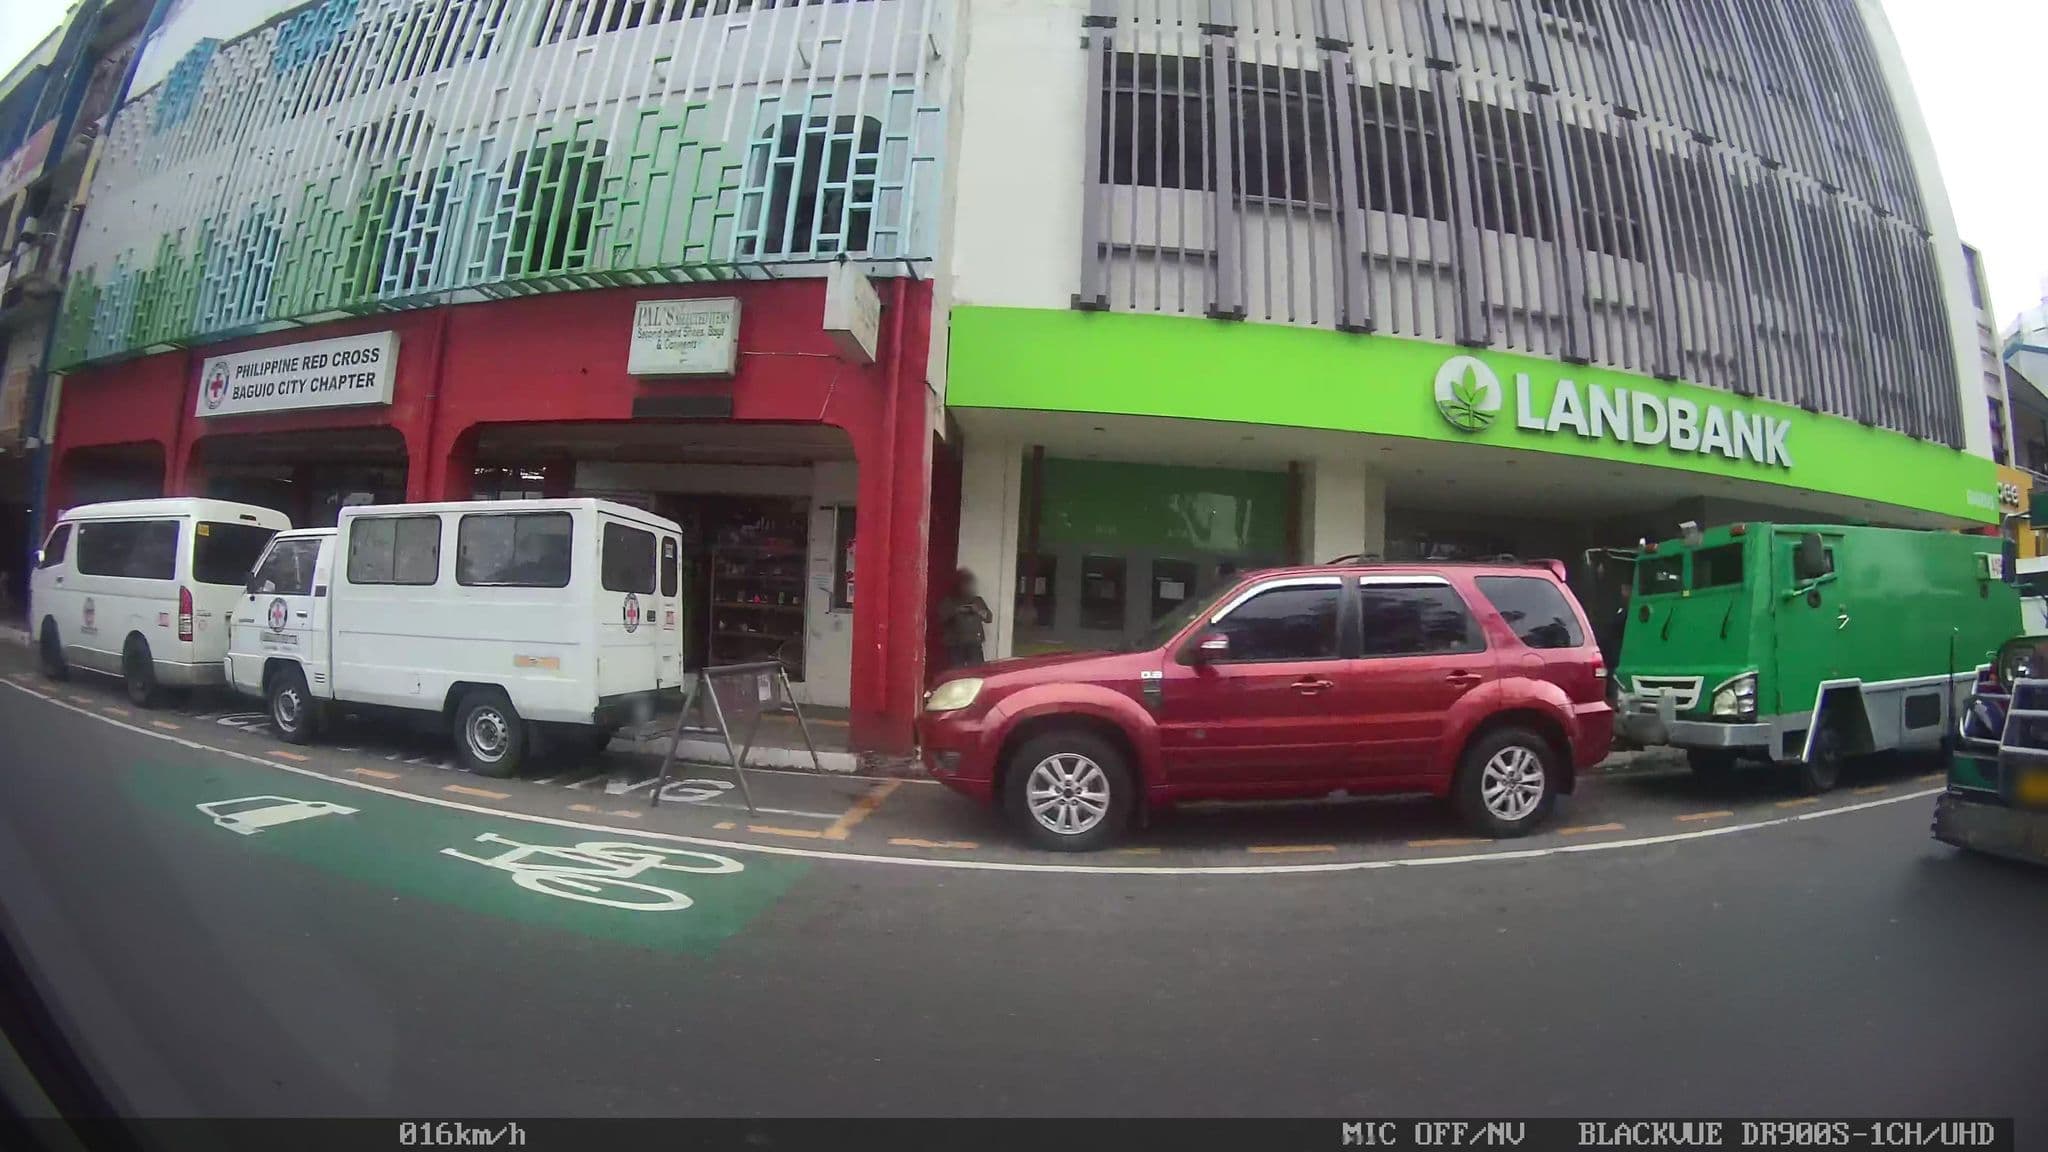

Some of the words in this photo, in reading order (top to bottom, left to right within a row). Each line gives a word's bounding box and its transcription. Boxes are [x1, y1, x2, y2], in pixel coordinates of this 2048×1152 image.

[235, 357, 300, 379] PHILIPPINE
[302, 353, 328, 371] RED
[331, 348, 380, 367] CROSS
[232, 382, 275, 400] BAGUIO
[278, 378, 308, 396] CITY
[310, 372, 376, 392] CHAPTER
[1515, 372, 1793, 468] LANDBANK
